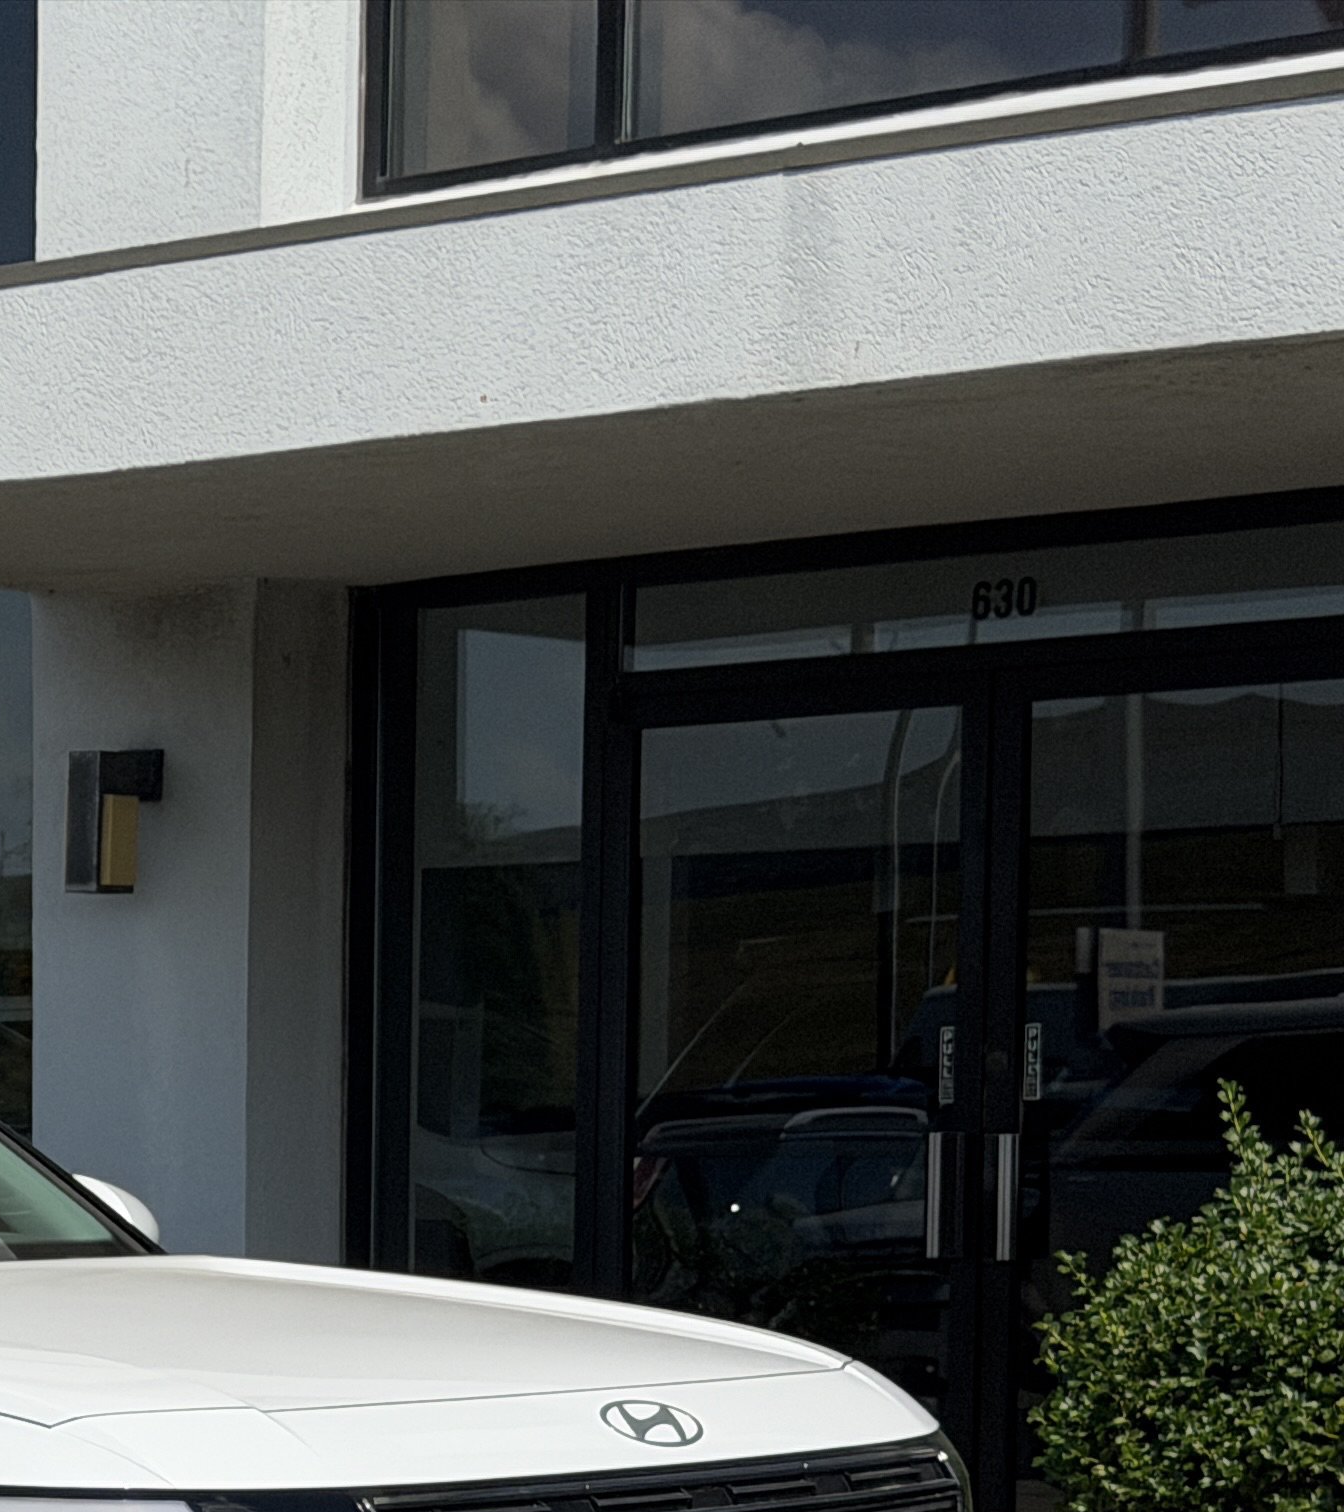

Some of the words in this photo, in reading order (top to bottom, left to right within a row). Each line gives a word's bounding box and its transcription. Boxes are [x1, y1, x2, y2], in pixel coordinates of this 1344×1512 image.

[972, 576, 1037, 620] 630
[942, 1029, 954, 1079] PULL
[1027, 1026, 1039, 1078] PULL
